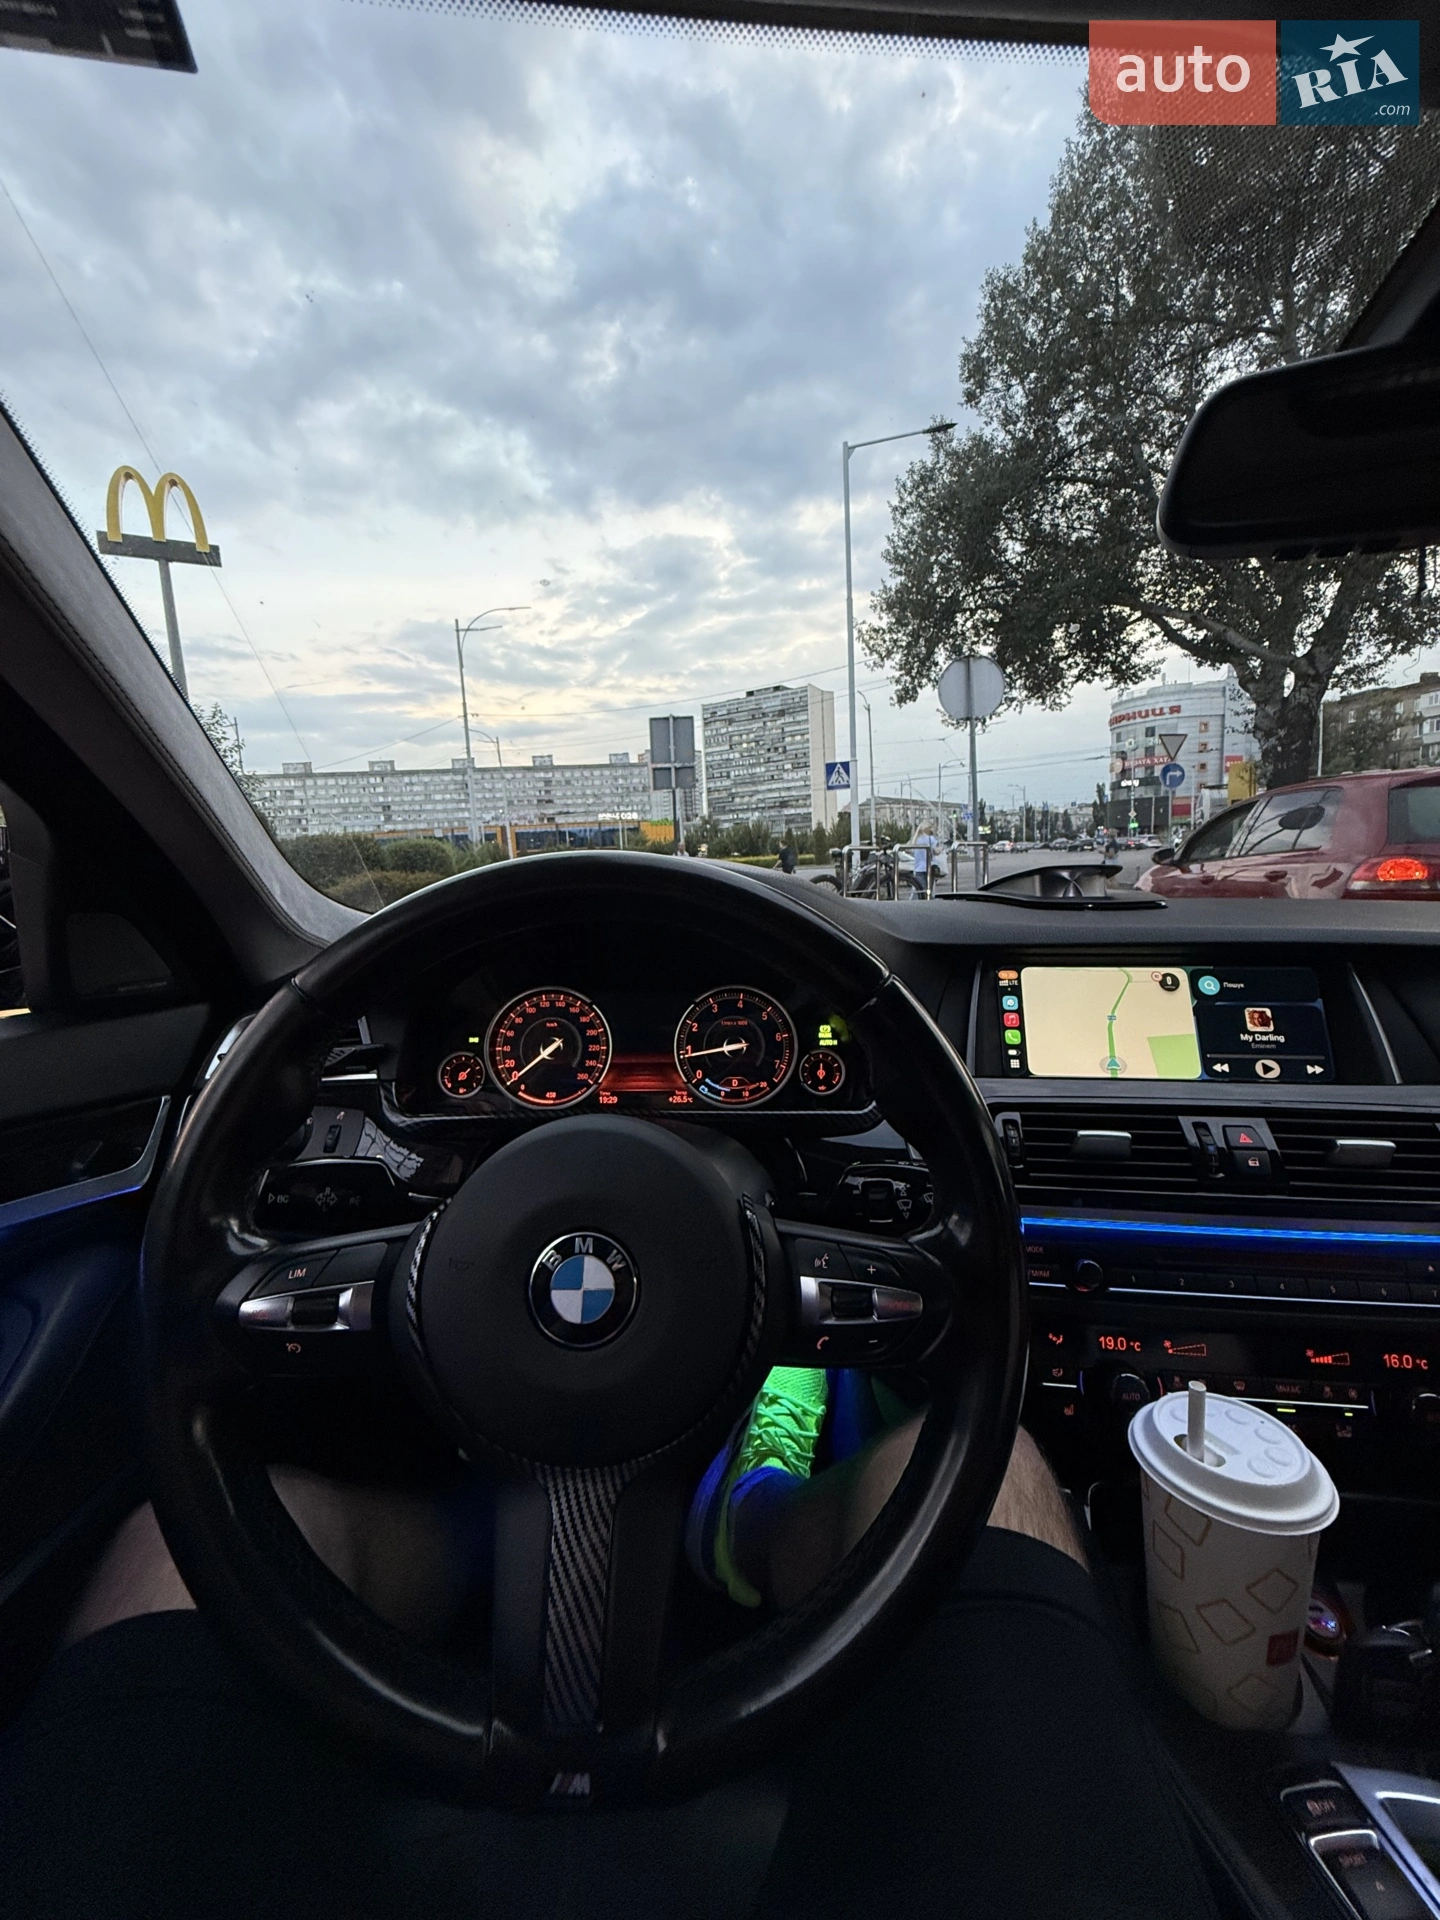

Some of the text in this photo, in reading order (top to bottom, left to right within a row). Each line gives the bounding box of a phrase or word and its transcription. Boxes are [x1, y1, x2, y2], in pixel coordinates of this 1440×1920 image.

[712, 1004, 718, 1012] 3
[737, 1000, 743, 1008] 4
[762, 1012, 768, 1020] 5
[692, 1022, 698, 1031] 2
[775, 1032, 782, 1041] 6
[1240, 1033, 1285, 1043] My Darling
[685, 1045, 692, 1056] 1
[774, 1060, 780, 1069] 7
[511, 1071, 519, 1080] 0
[696, 1070, 702, 1079] 0
[599, 1096, 617, 1104] 19:29
[542, 1237, 627, 1272] BMW
[288, 1267, 307, 1279] LIM
[1131, 1275, 1136, 1283] 1
[1179, 1278, 1185, 1286] 2
[1229, 1280, 1235, 1288] 3
[1330, 1285, 1336, 1293] 5
[1381, 1288, 1388, 1296] 6
[1098, 1336, 1127, 1351] 19.0
[1383, 1354, 1413, 1369] 16.0
[1122, 1392, 1141, 1400] AUTO
